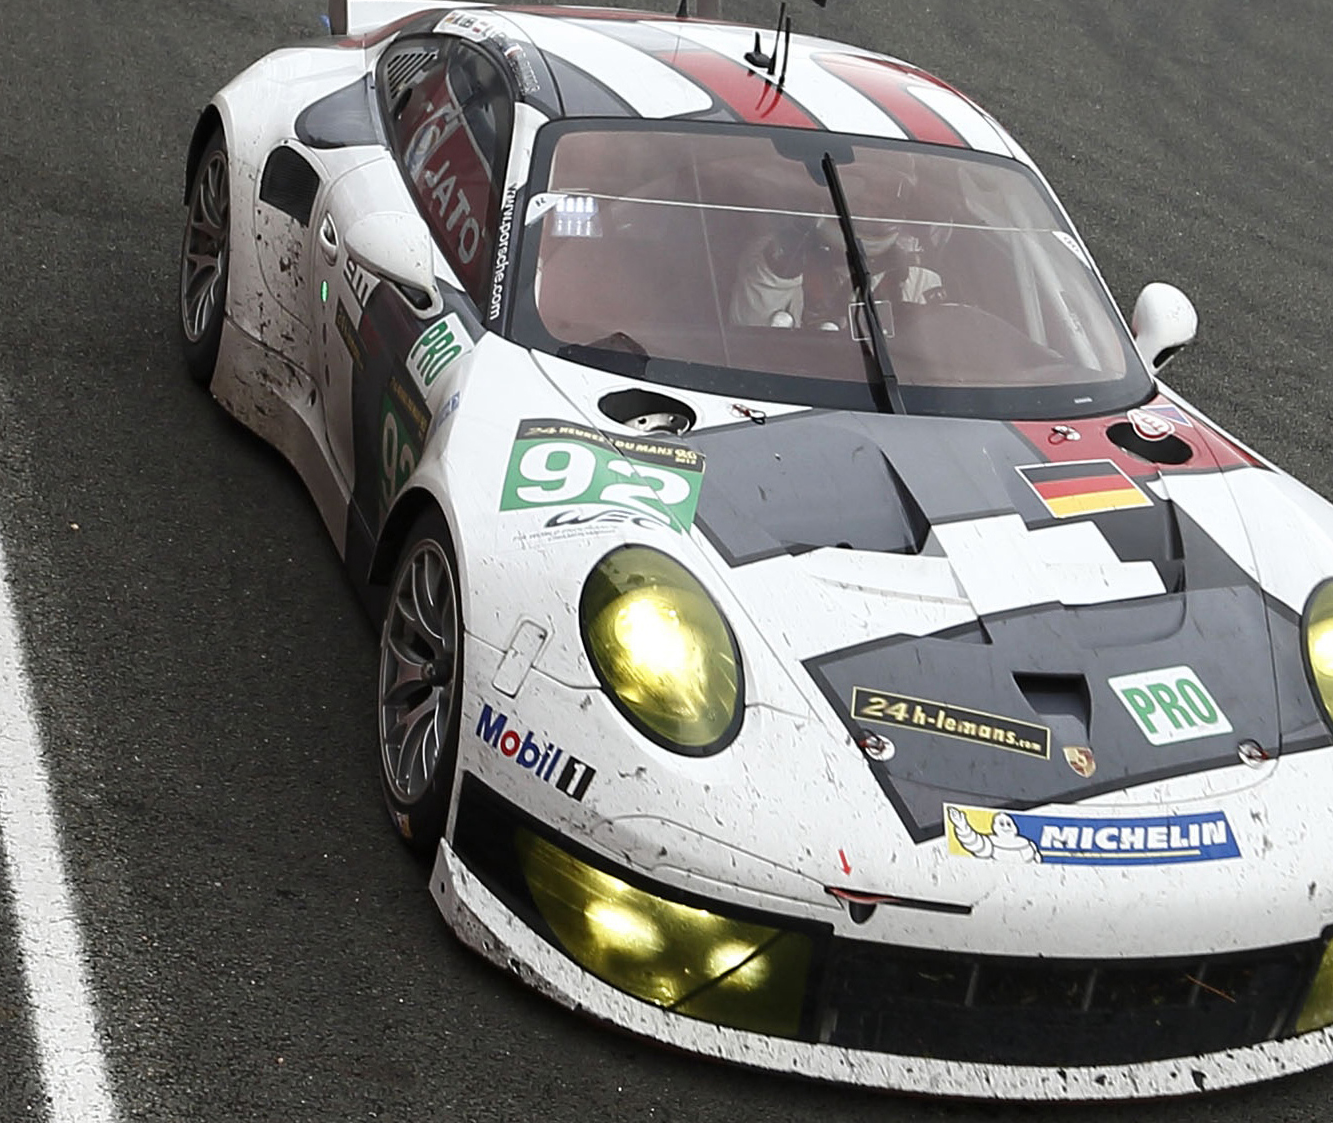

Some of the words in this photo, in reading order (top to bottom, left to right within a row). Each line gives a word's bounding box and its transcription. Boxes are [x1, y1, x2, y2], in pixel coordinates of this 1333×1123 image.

[411, 321, 462, 387] PRO
[517, 442, 691, 525] 92
[1120, 678, 1219, 734] PRO
[475, 703, 564, 783] Mobil
[1039, 820, 1228, 851] MICHELIN
